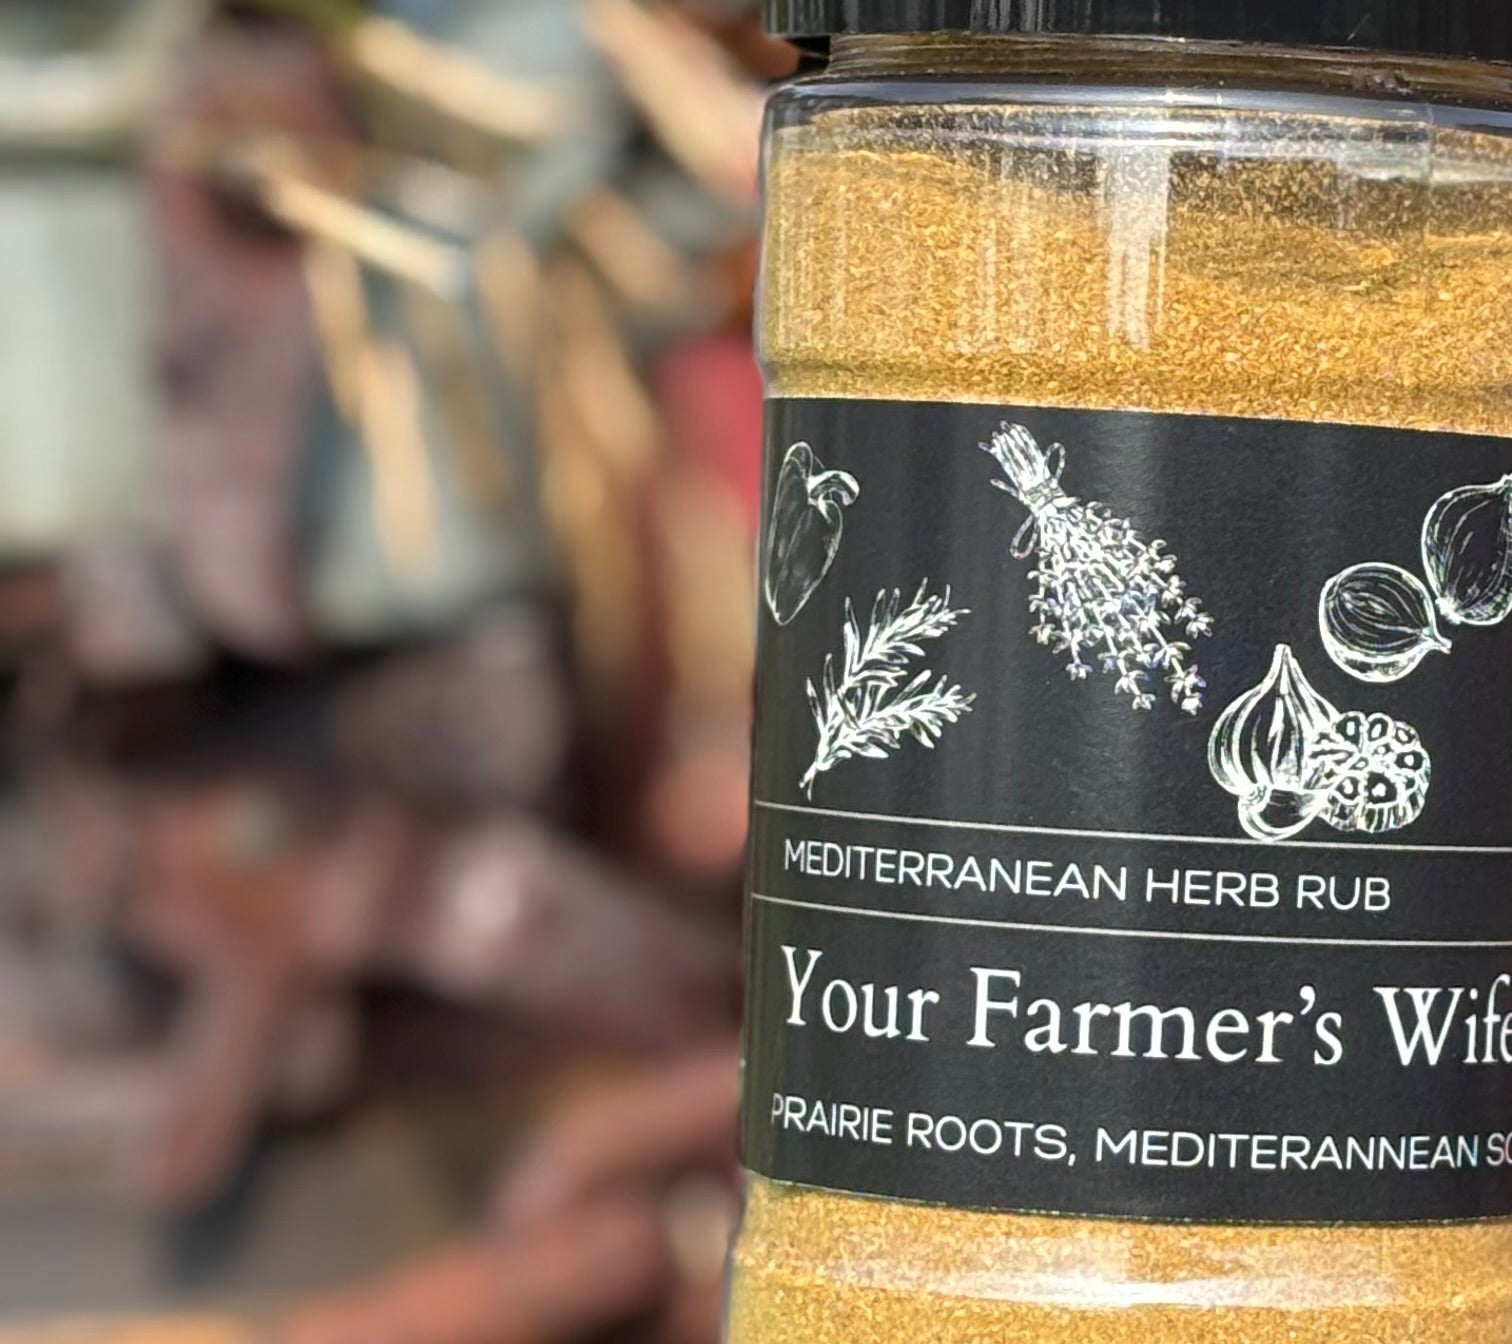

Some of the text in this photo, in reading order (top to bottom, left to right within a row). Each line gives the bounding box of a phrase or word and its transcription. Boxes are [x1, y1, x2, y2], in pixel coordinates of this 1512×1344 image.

[784, 837, 1391, 912] MEDITERRANEAN HERB RUB
[780, 944, 941, 1042] Your
[965, 966, 1344, 1066] Farmer’s
[771, 1092, 894, 1145] PRAIRIE
[906, 1112, 1077, 1167] ROOTS,
[1095, 1127, 1479, 1171] MEDITERANNEAN
